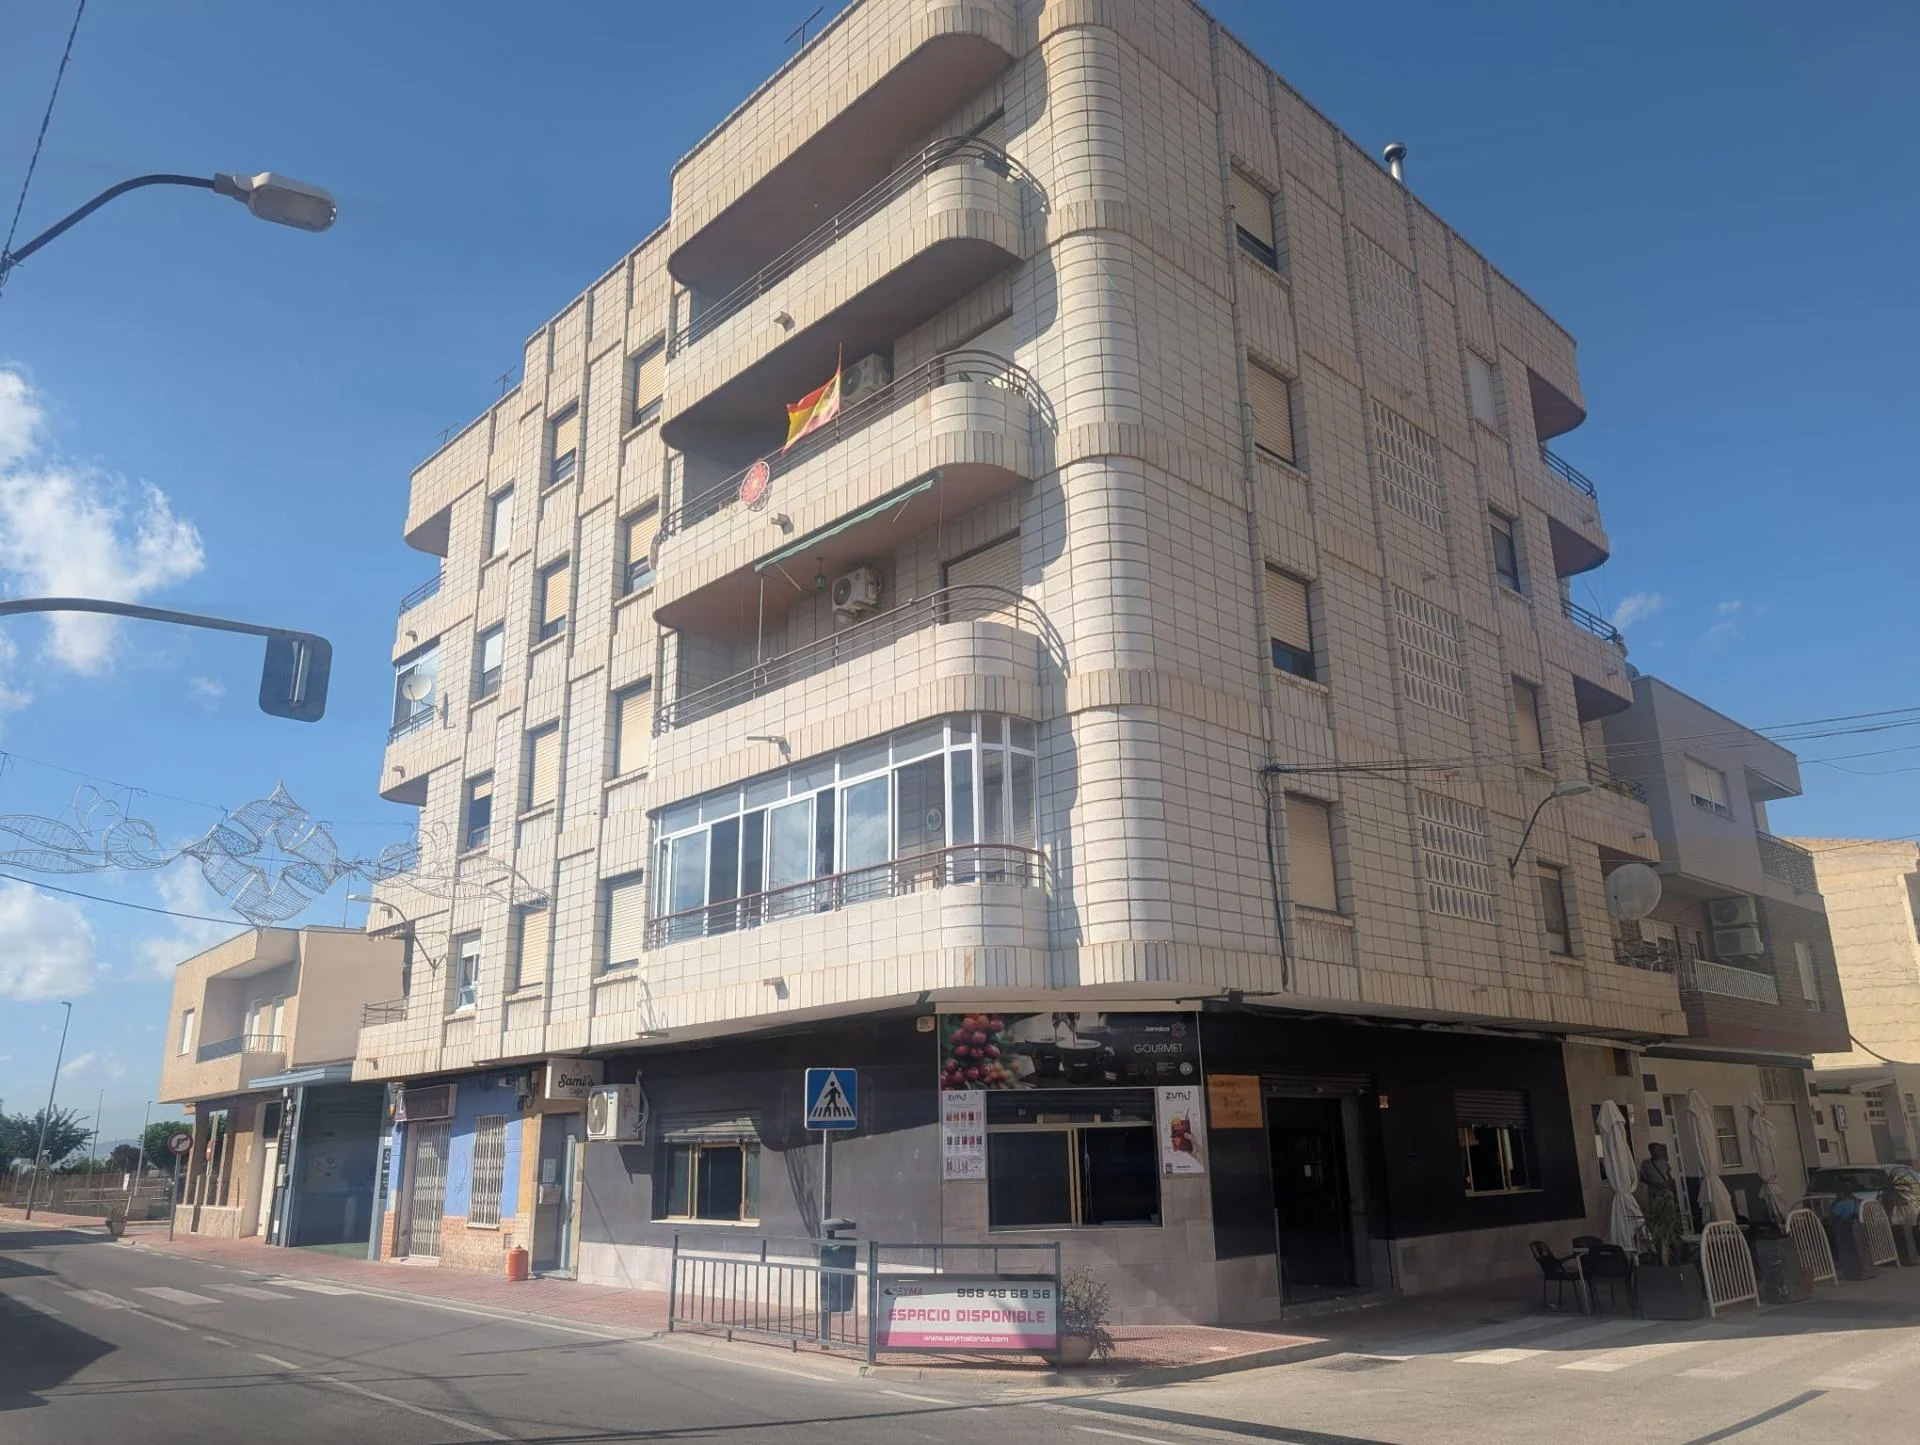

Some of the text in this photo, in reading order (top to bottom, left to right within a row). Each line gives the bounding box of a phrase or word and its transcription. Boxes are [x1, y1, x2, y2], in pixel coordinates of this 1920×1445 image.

[1133, 1043, 1184, 1054] GOURMET
[557, 1073, 594, 1088] Sami's
[957, 1287, 985, 1298] 968
[1010, 1288, 1029, 1299] 68
[1032, 1289, 1051, 1299] 58
[889, 1308, 1045, 1324] ESPACIO DISPONIBLE
